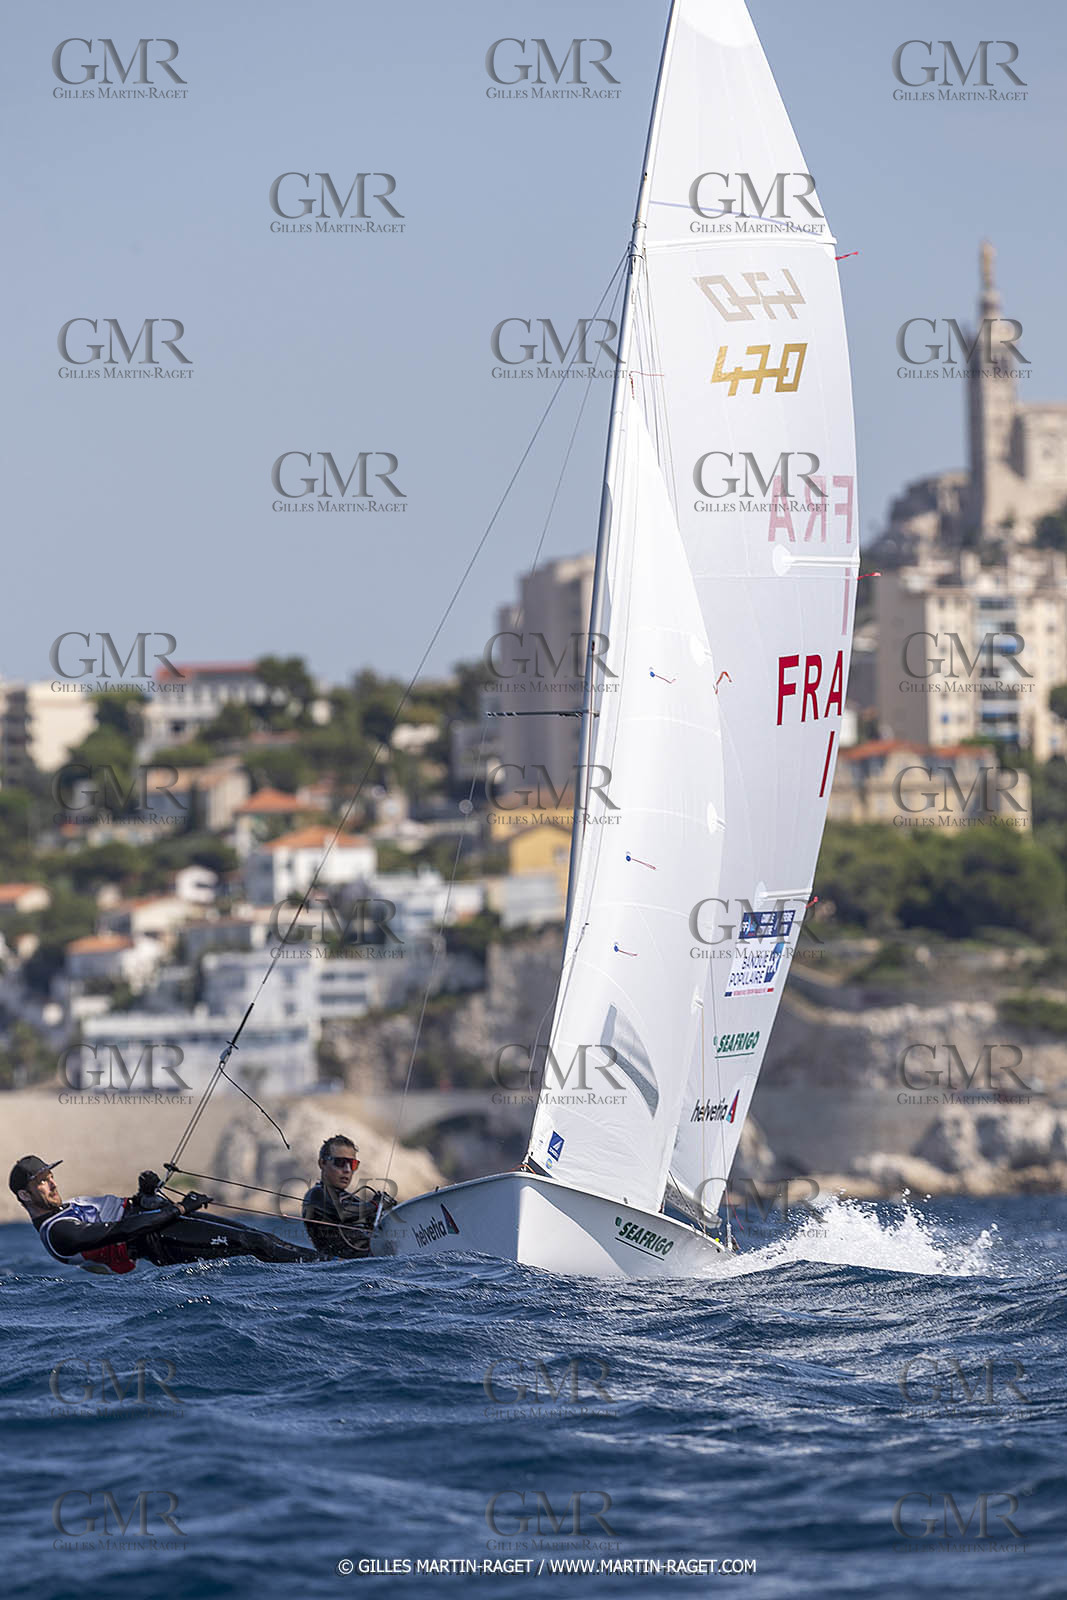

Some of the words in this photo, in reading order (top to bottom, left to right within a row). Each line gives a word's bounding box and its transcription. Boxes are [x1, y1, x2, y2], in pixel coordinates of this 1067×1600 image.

[710, 343, 808, 396] 470
[776, 650, 843, 725] FRA
[728, 970, 765, 986] POPULAIRE
[716, 1030, 760, 1053] SEAFRIGO
[690, 1097, 728, 1122] helvetia
[411, 1216, 448, 1248] helvetia
[618, 1222, 674, 1256] SEAFRIGO
